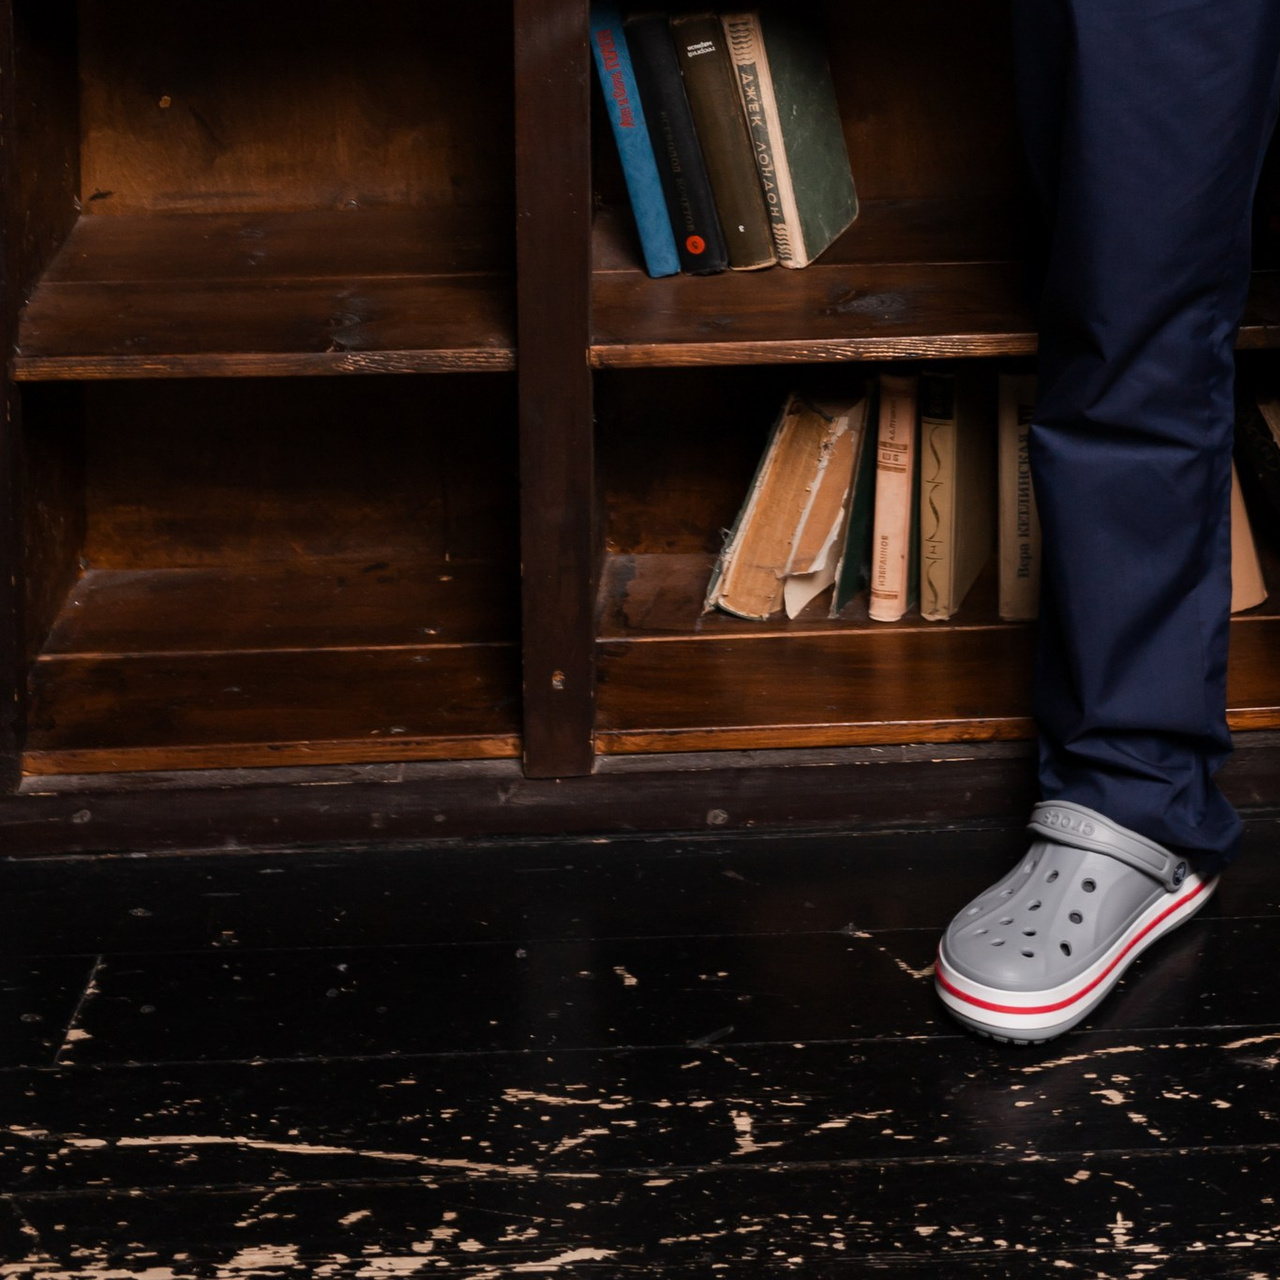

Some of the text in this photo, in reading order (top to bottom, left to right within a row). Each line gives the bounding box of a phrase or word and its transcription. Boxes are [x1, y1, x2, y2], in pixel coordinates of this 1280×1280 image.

[740, 71, 782, 217] ДЖЕК ЛОНДОН
[878, 535, 888, 586] ИЗБРАННОЕ
[1014, 432, 1032, 578] Вера КЕТЛИНСКАЯ
